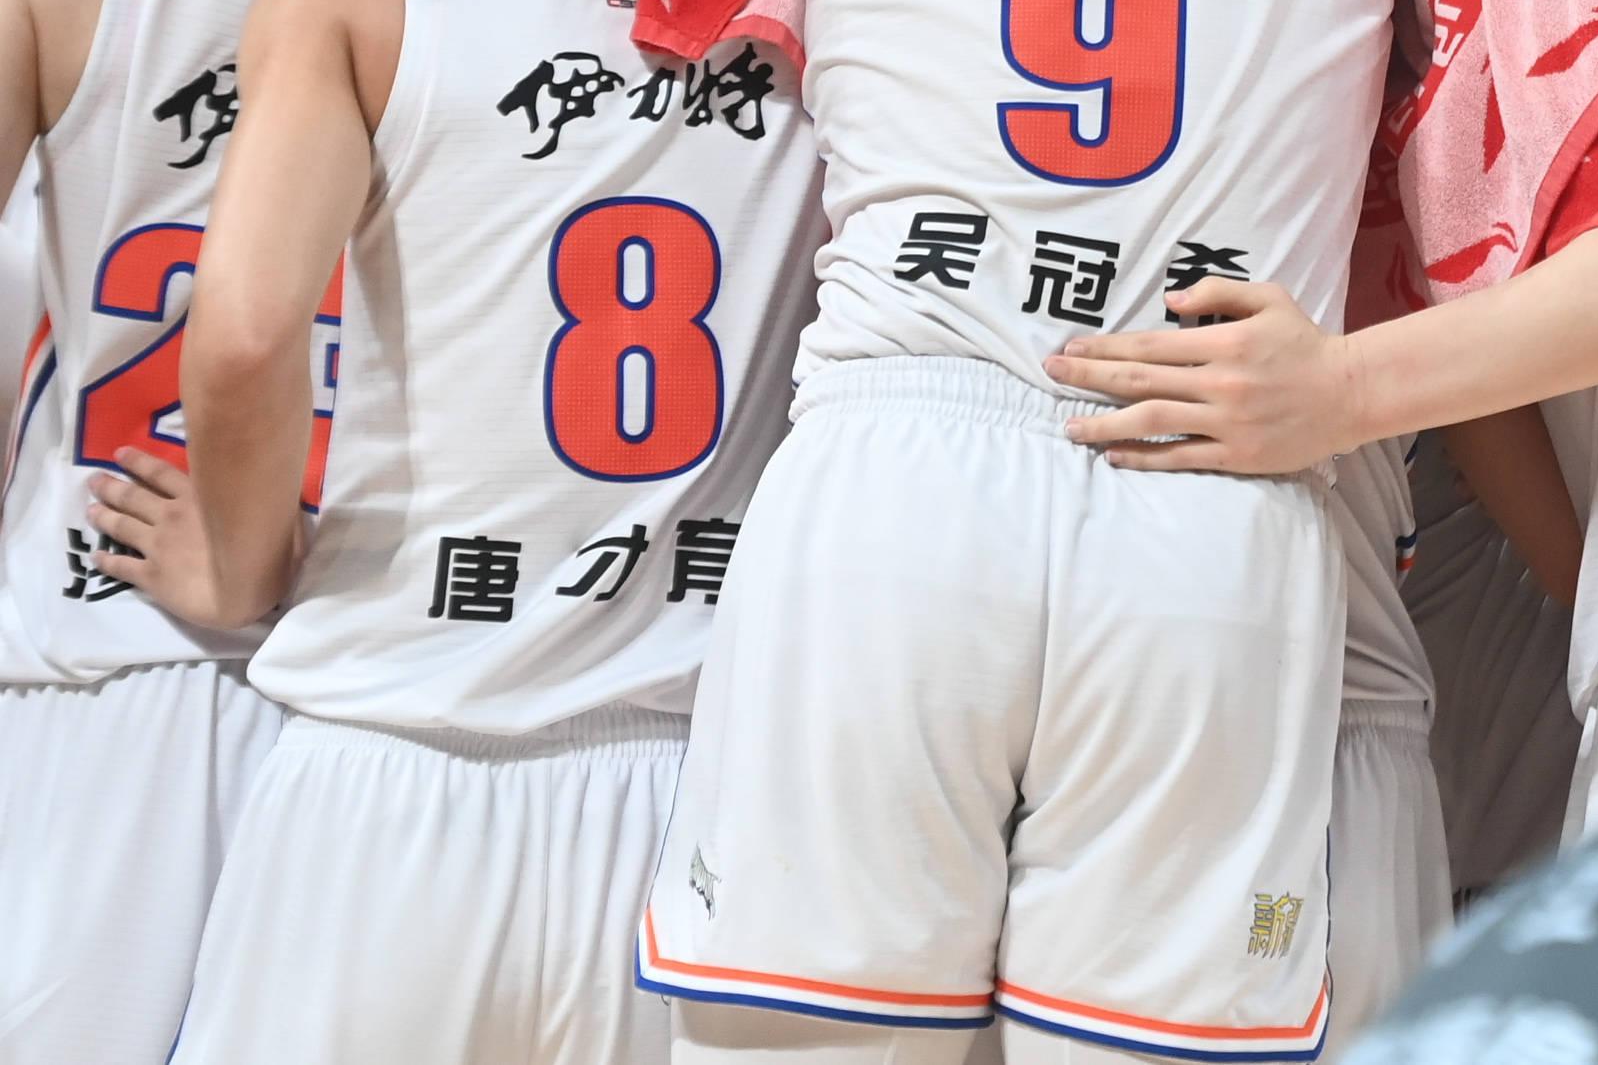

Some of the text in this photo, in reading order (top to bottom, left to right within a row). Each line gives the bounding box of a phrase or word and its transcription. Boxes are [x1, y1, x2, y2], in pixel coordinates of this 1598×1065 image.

[497, 43, 776, 160] 伊力特
[543, 196, 724, 483] 8
[428, 518, 741, 623] 唐才育
